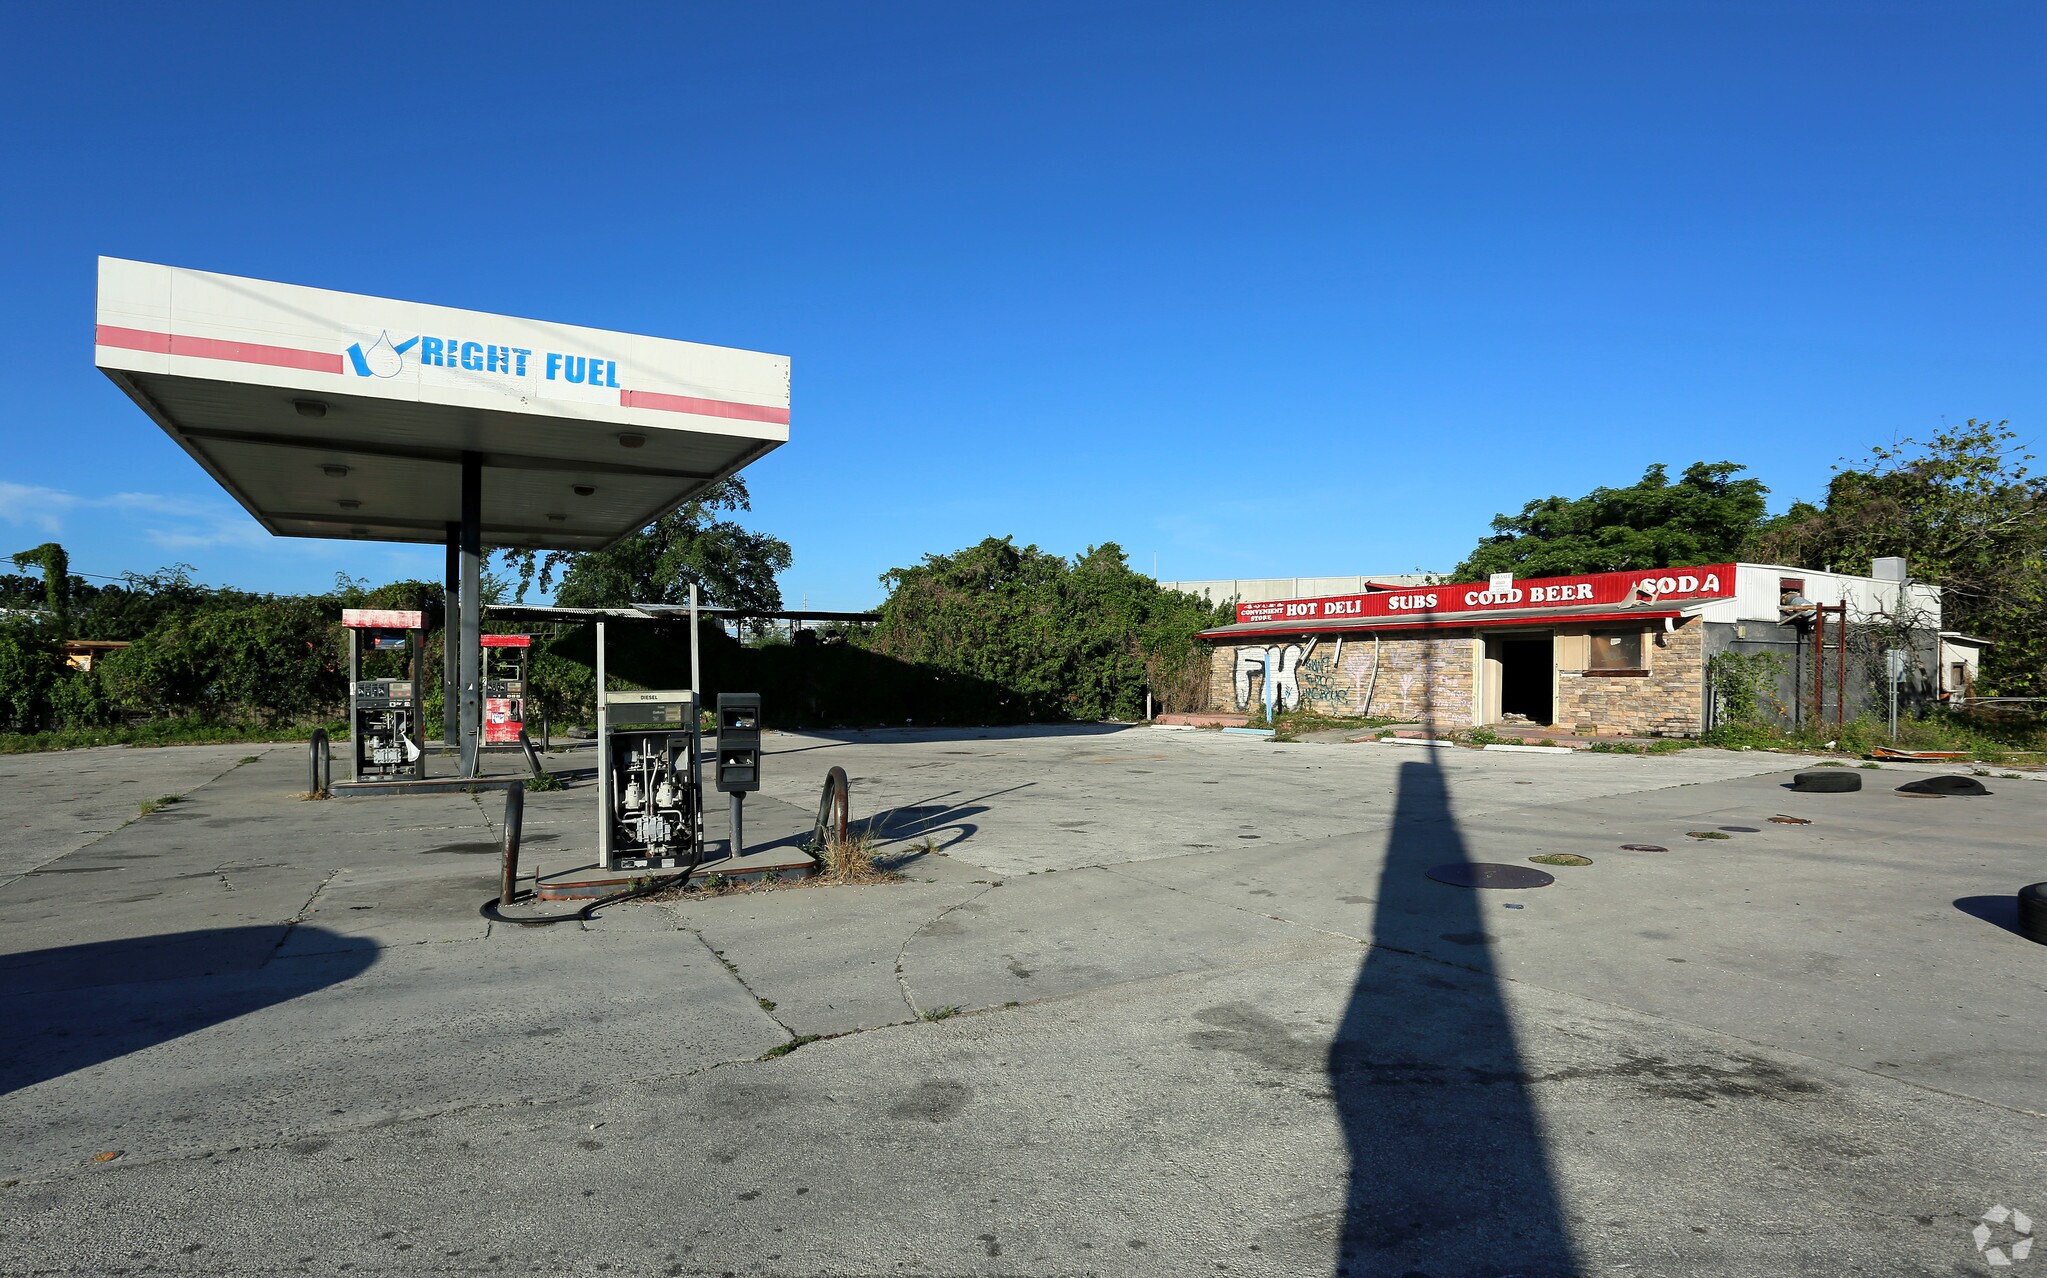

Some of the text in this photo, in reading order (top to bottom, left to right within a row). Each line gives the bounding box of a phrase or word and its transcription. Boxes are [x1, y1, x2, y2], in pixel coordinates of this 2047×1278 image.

[421, 335, 621, 389] RIGHT FUEL
[1640, 573, 1720, 595] SODA
[1388, 593, 1438, 610] SUBS
[1464, 583, 1594, 606] COLD BEER
[1240, 607, 1285, 616] CONVENIENT
[1286, 602, 1318, 617] HOT
[1324, 599, 1362, 615] DELI
